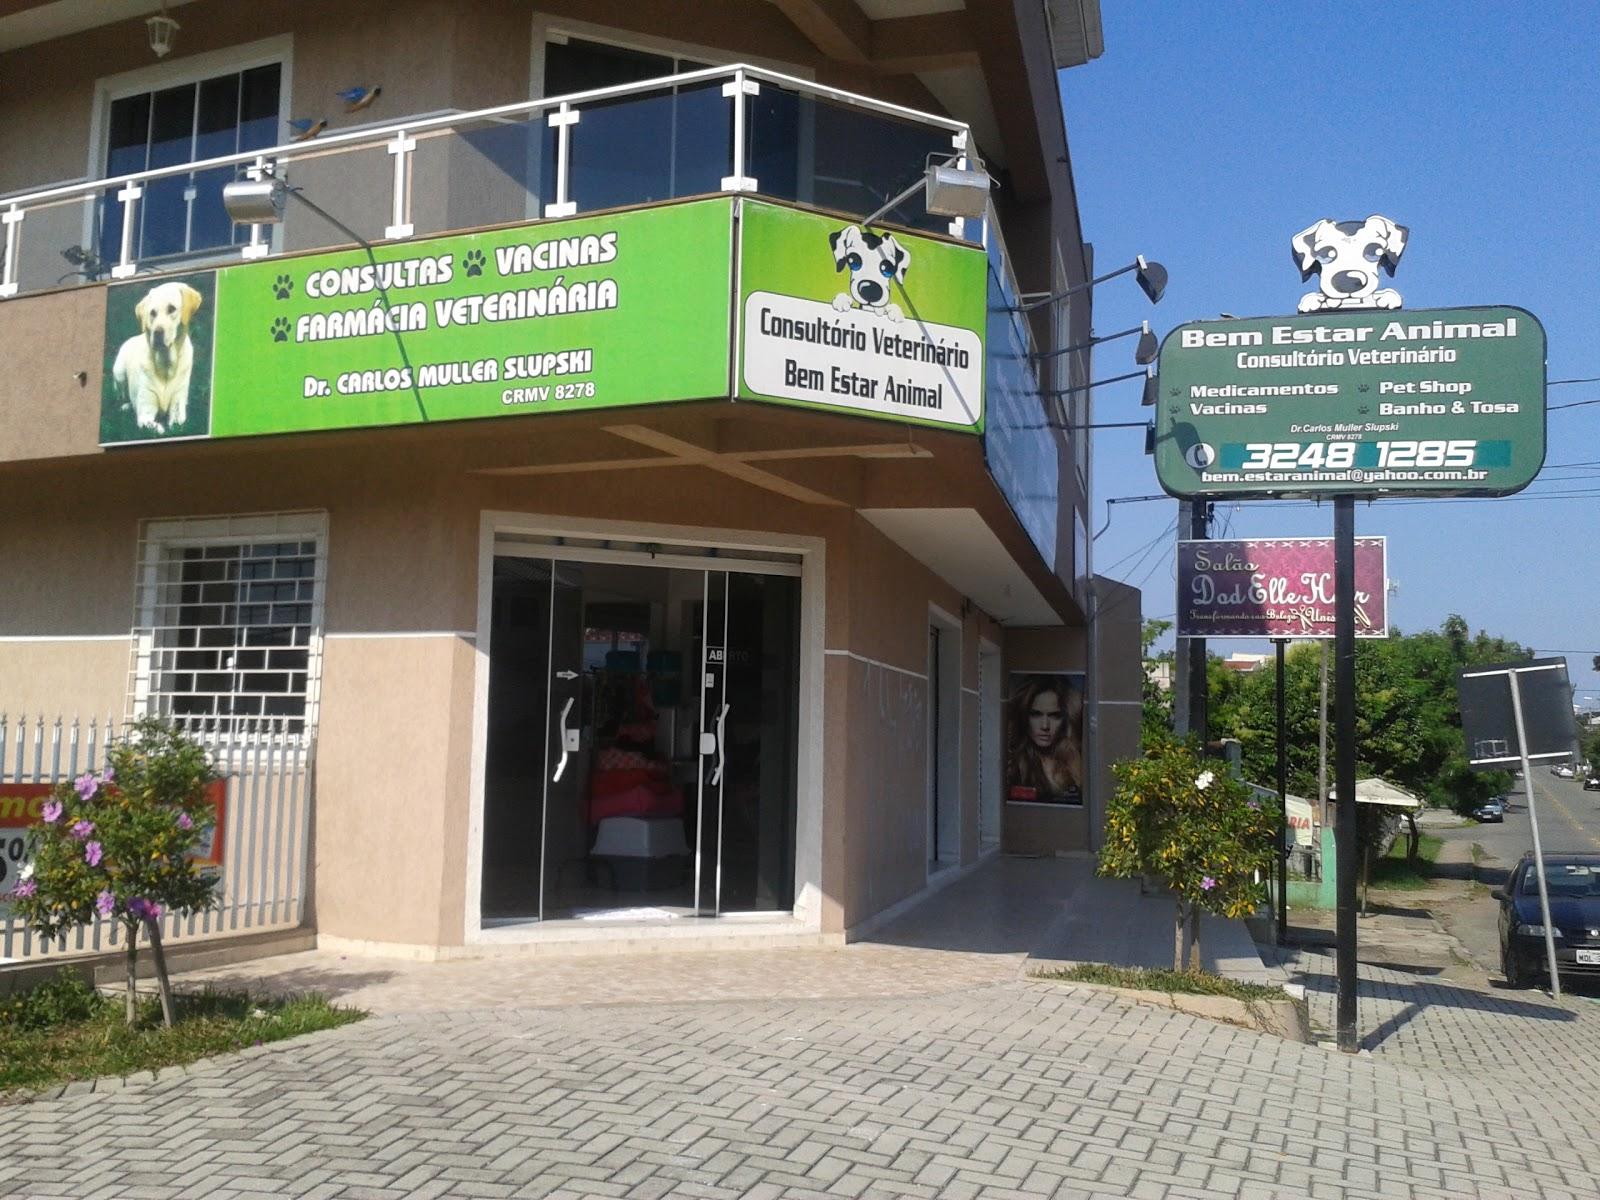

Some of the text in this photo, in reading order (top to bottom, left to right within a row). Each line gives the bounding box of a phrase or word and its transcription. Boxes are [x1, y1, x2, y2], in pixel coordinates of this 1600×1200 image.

[305, 231, 617, 298] CONSULTAS VACINAS
[296, 276, 618, 343] FARMÁCIA VETERINÁRIA
[761, 308, 969, 370] Consultório Veterinário
[1181, 318, 1518, 348] Bem Estar Animal
[1237, 347, 1456, 369] Consultório Veterinário
[303, 349, 593, 398] Dr. CARLOS MULLER SLUPSKI
[785, 359, 943, 410] Bem Estar Animal
[502, 382, 595, 404] CRMV 8278
[1190, 384, 1339, 398] Medicamentos
[1379, 380, 1472, 395] Pet Shop
[1190, 403, 1268, 415] Vacinas
[1379, 400, 1519, 416] Banho & Tosa
[1334, 423, 1362, 432] Muller
[1365, 422, 1399, 433] Slupski
[1347, 433, 1362, 441] 8278
[1241, 440, 1477, 469] 3248 1285
[1202, 469, 1488, 483] bem.estaranimal@yahoo.com.br
[1194, 550, 1259, 572] Salão
